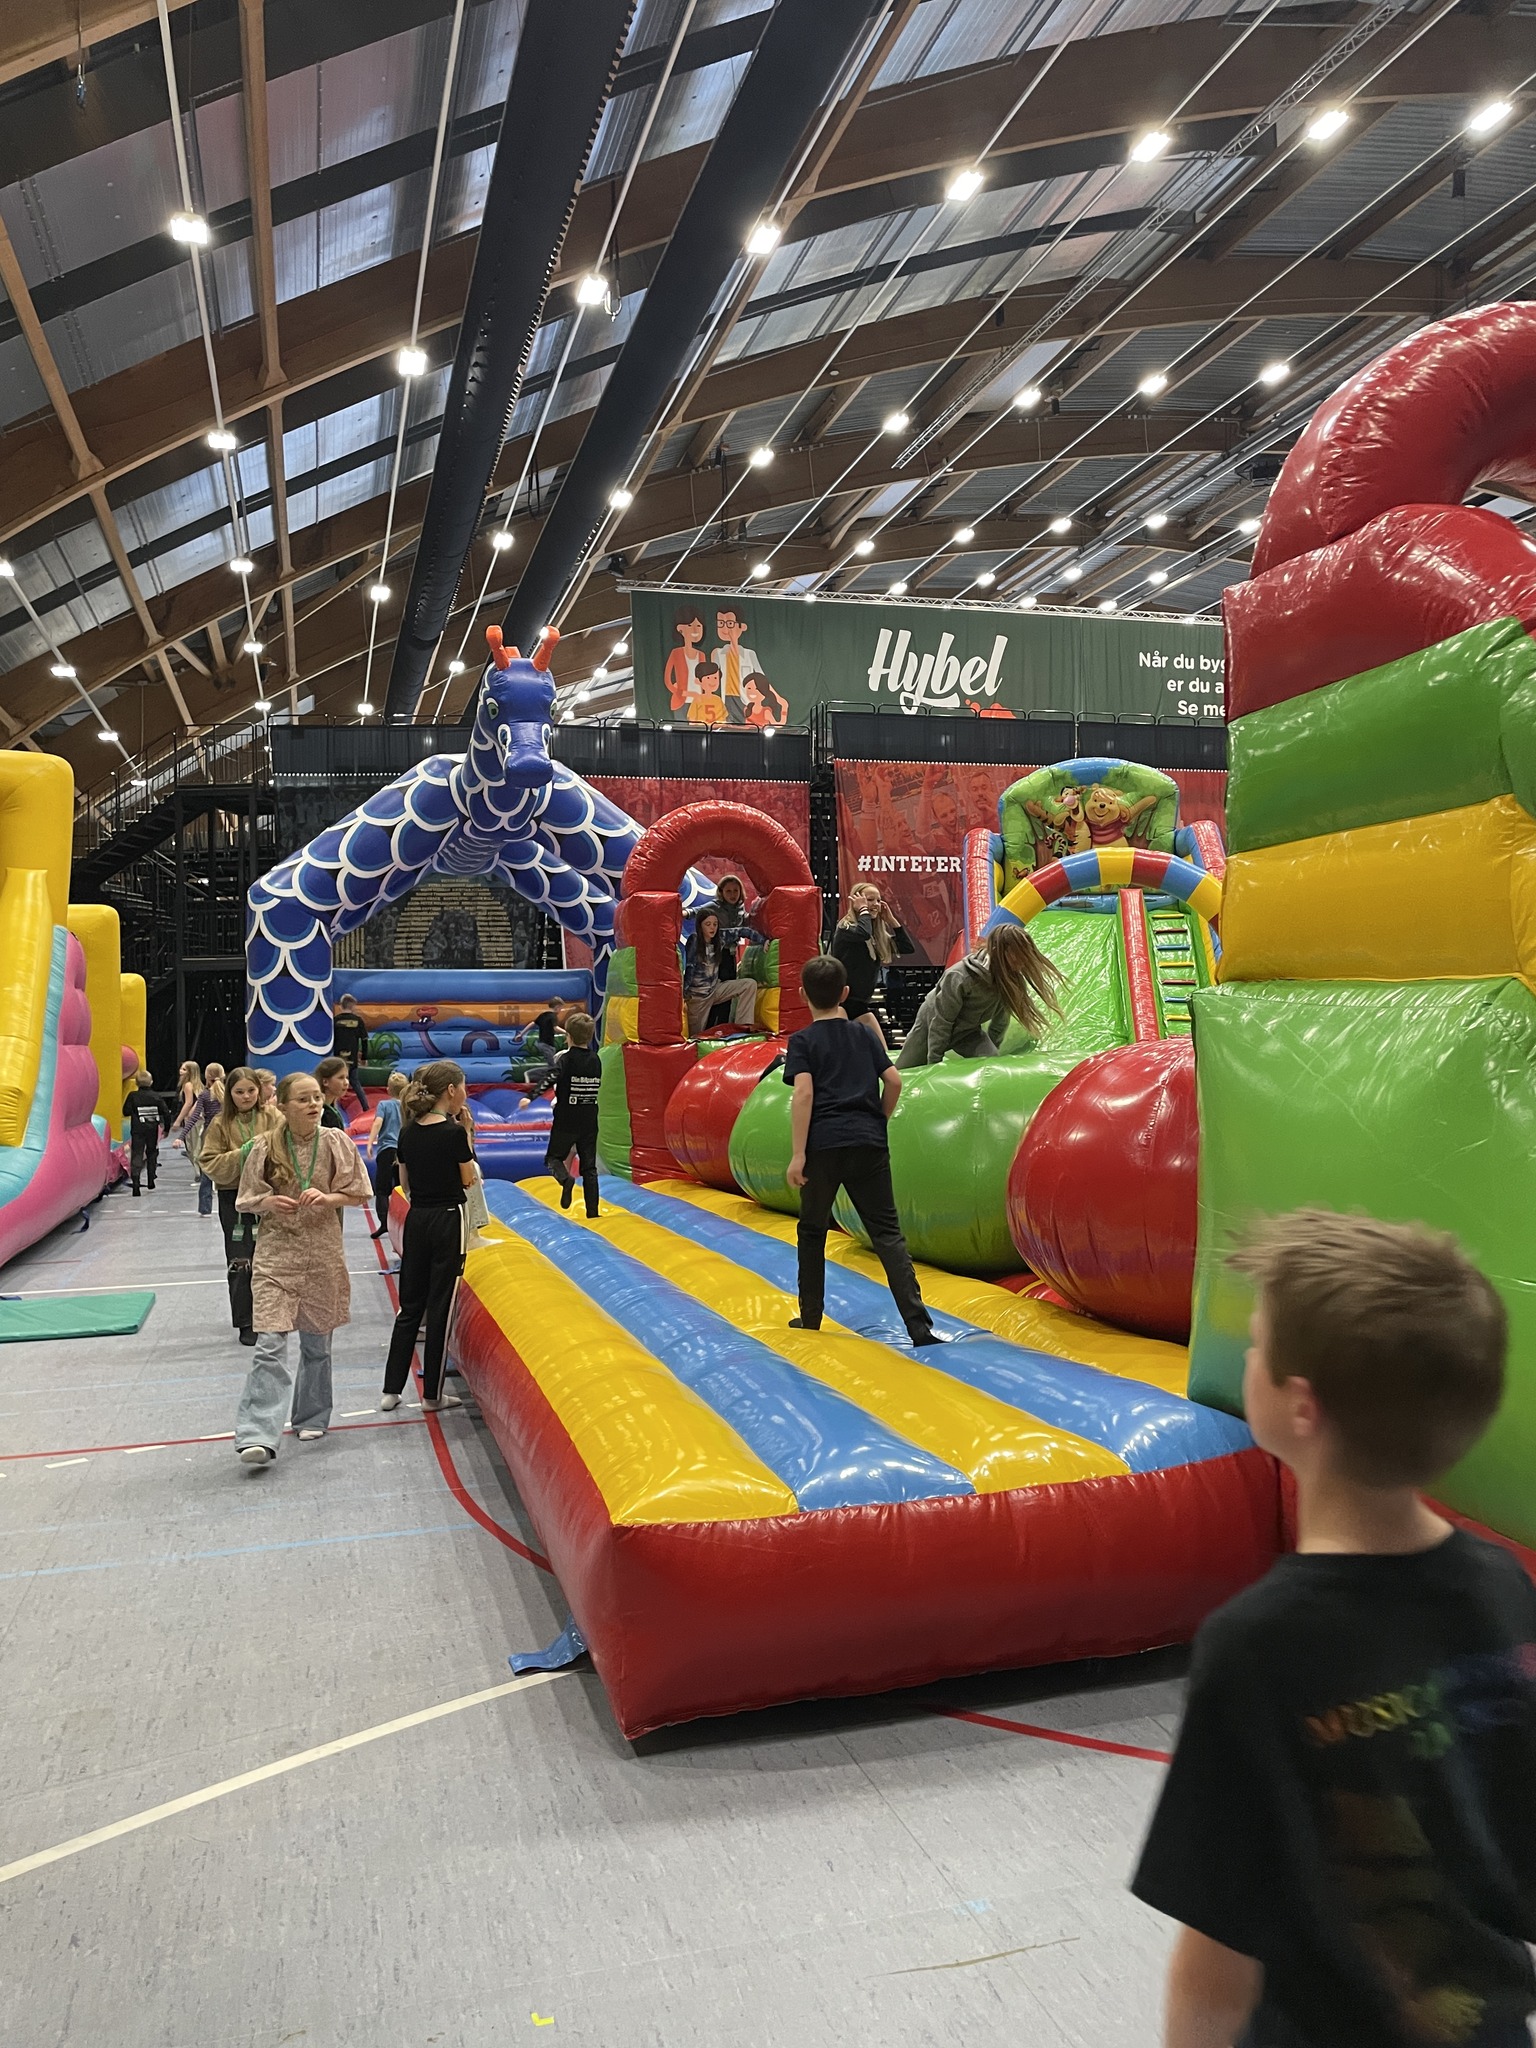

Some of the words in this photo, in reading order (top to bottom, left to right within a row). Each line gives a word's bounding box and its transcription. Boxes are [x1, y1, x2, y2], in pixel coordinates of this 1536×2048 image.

[1139, 650, 1169, 668] Når
[1173, 653, 1195, 669] du
[868, 628, 1008, 715] Hybel
[1167, 679, 1184, 692] er
[1188, 677, 1210, 693] du
[704, 704, 716, 723] 5
[1177, 700, 1198, 716] Se
[857, 855, 964, 873] #INTETER
